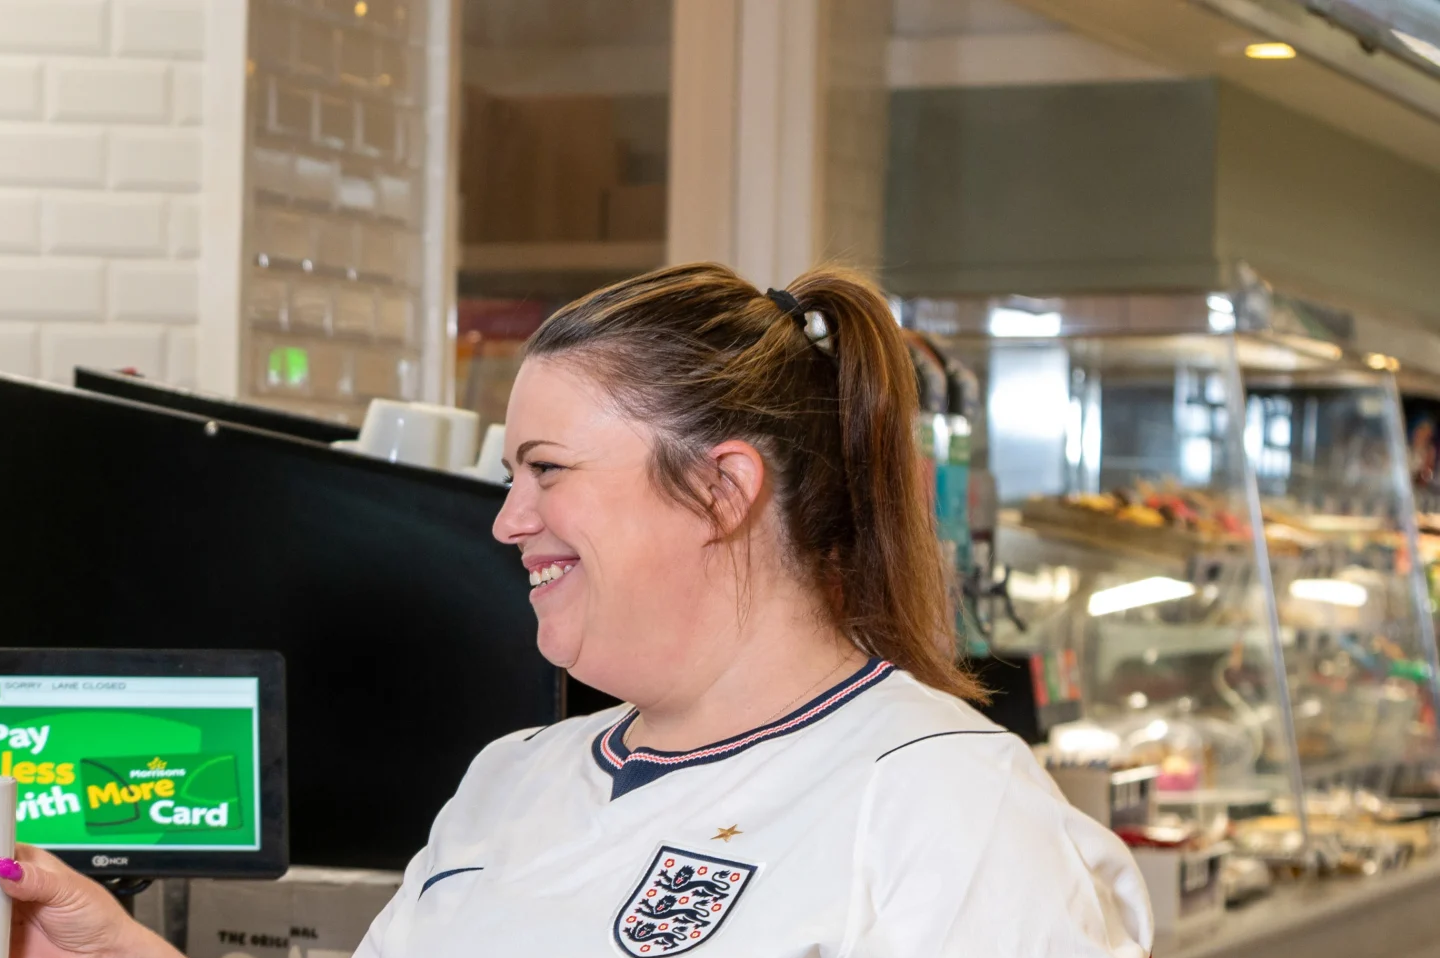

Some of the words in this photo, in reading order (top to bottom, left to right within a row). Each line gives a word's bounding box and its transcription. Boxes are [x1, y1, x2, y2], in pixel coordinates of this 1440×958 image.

[4, 682, 42, 690] SORRY
[51, 682, 79, 691] LANE
[81, 682, 127, 691] CLOSED
[1, 751, 76, 785] less
[129, 768, 186, 779] Morrisons
[87, 778, 175, 810] More
[149, 800, 229, 827] Card
[217, 930, 247, 946] THE
